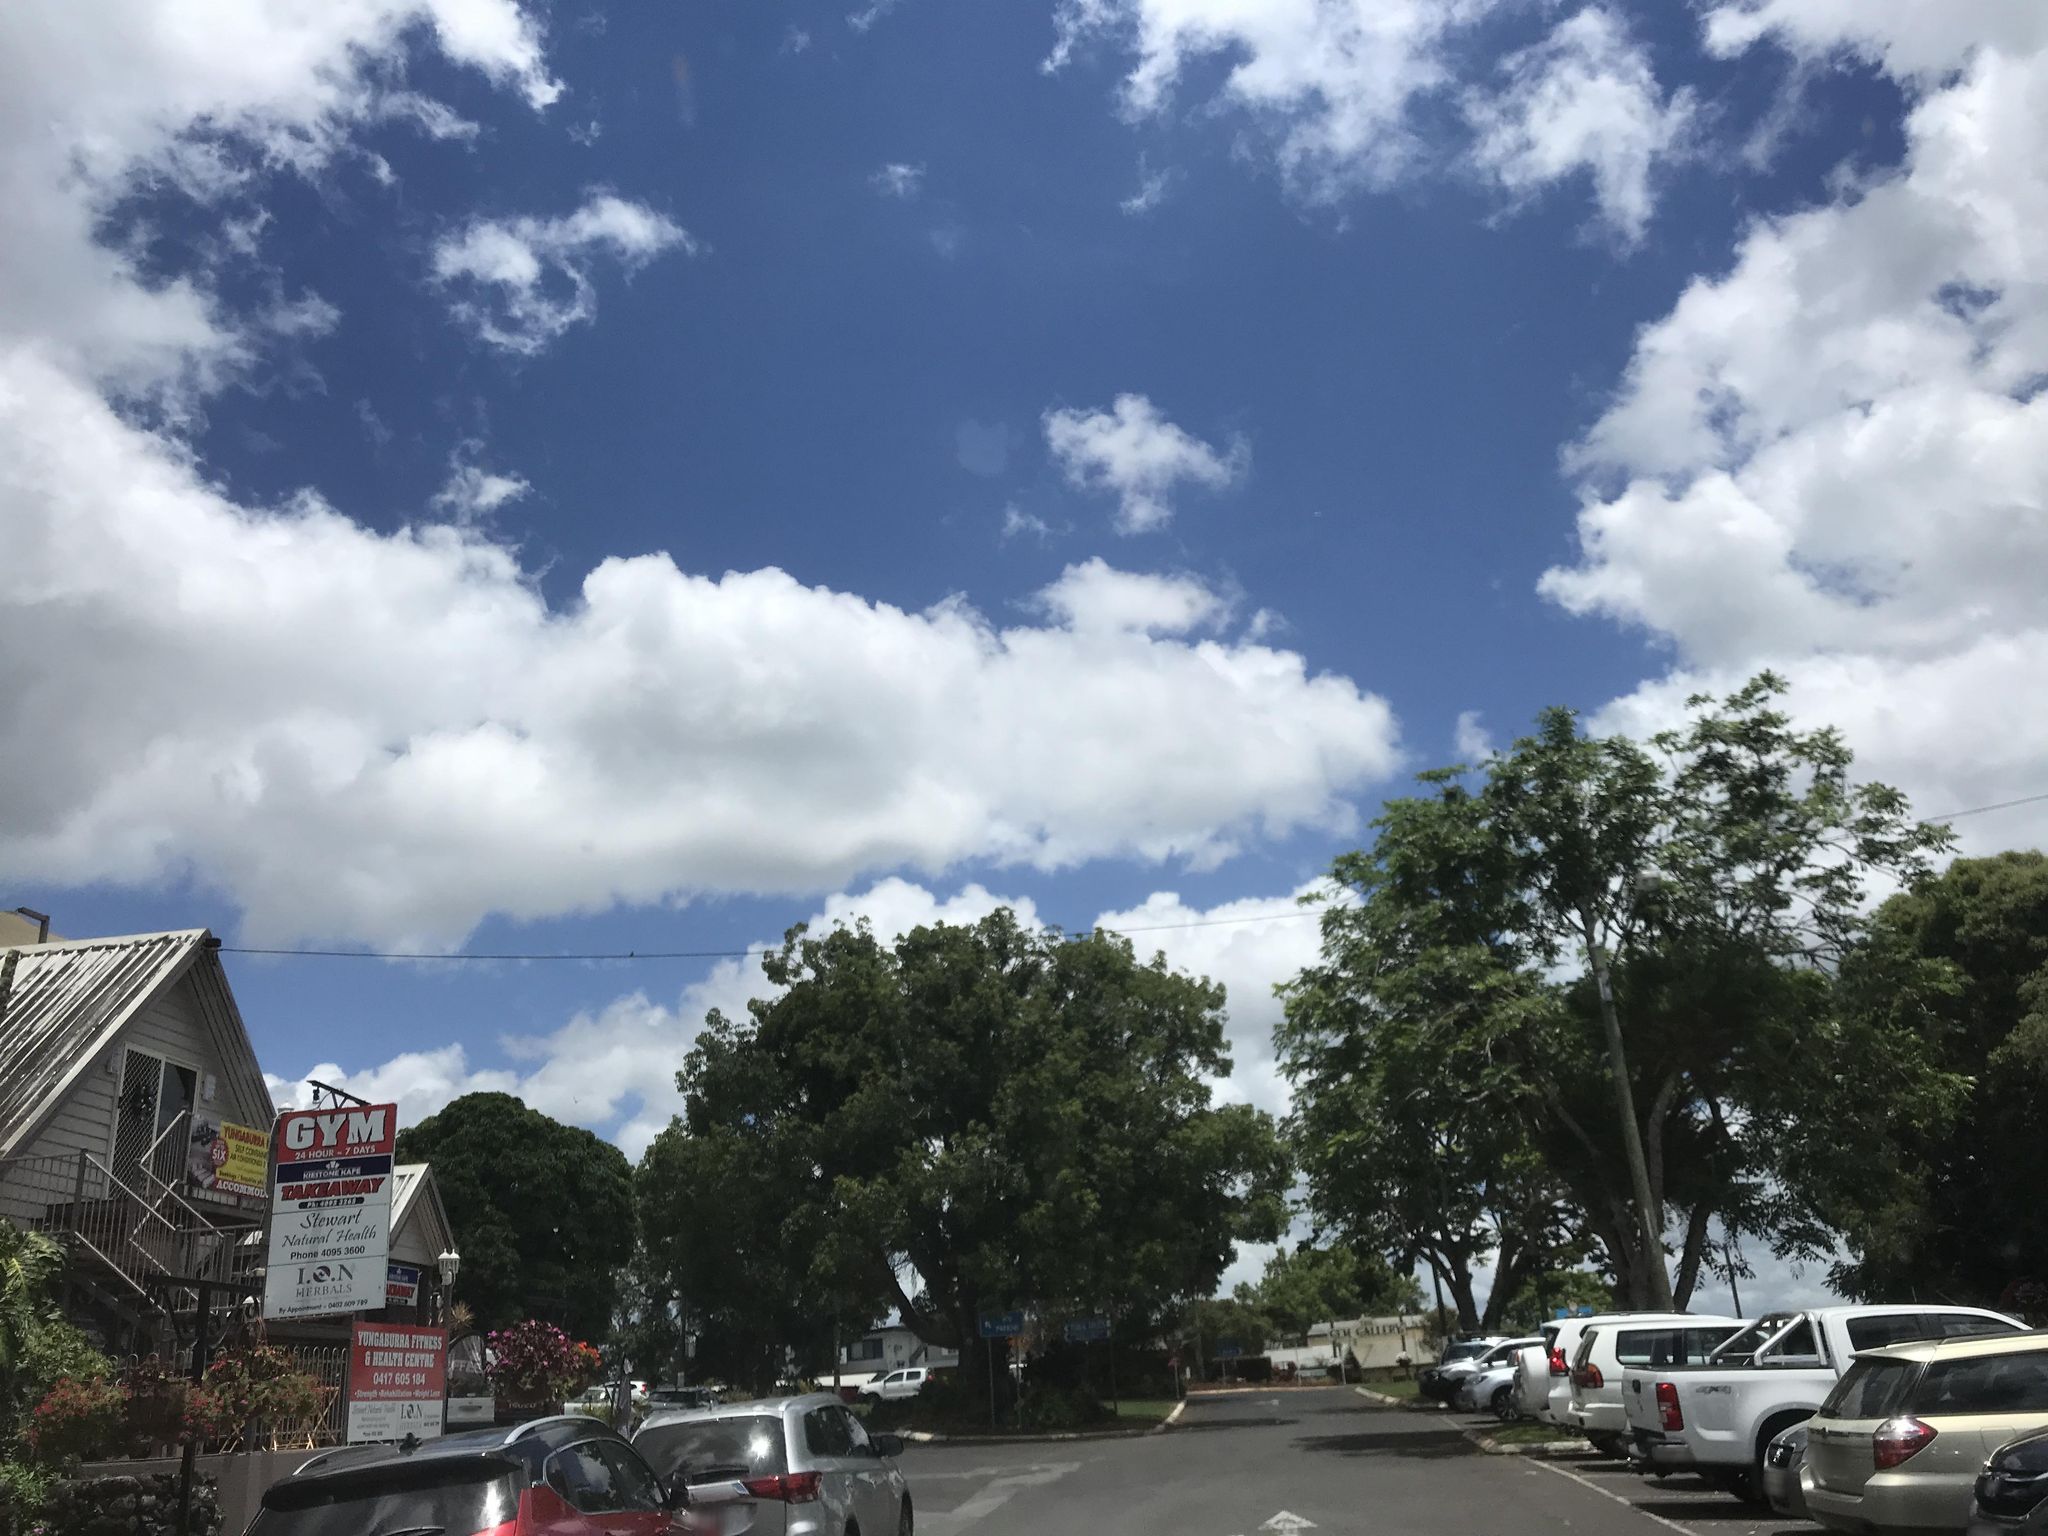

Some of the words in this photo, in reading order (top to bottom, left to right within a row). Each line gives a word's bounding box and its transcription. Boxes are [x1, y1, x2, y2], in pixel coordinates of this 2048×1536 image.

[223, 1126, 265, 1148] YUNGABURRA
[286, 1109, 386, 1150] GYM
[212, 1148, 226, 1160] SIX
[295, 1151, 306, 1160] 24
[308, 1149, 334, 1159] HOUR
[353, 1145, 375, 1154] DAYS
[340, 1167, 361, 1176] KAFE
[281, 1177, 386, 1201] TAKEAWAY
[300, 1208, 362, 1229] Stewart
[282, 1229, 333, 1248] Natural
[337, 1224, 377, 1242] Health
[290, 1250, 318, 1260] Phone
[321, 1247, 342, 1257] 4095
[344, 1245, 365, 1254] 3600
[296, 1284, 352, 1298] HERBALS
[287, 1304, 322, 1313] Appointment
[356, 1298, 368, 1306] 789
[358, 1330, 410, 1348] YUNGABURRA
[411, 1334, 442, 1350] FITNESS
[372, 1351, 403, 1367] HEALTH
[404, 1352, 435, 1368] CENTRE
[373, 1372, 393, 1385] 0417
[395, 1372, 410, 1385] 605
[412, 1373, 426, 1385] 184
[508, 1400, 536, 1409] ISUZU
